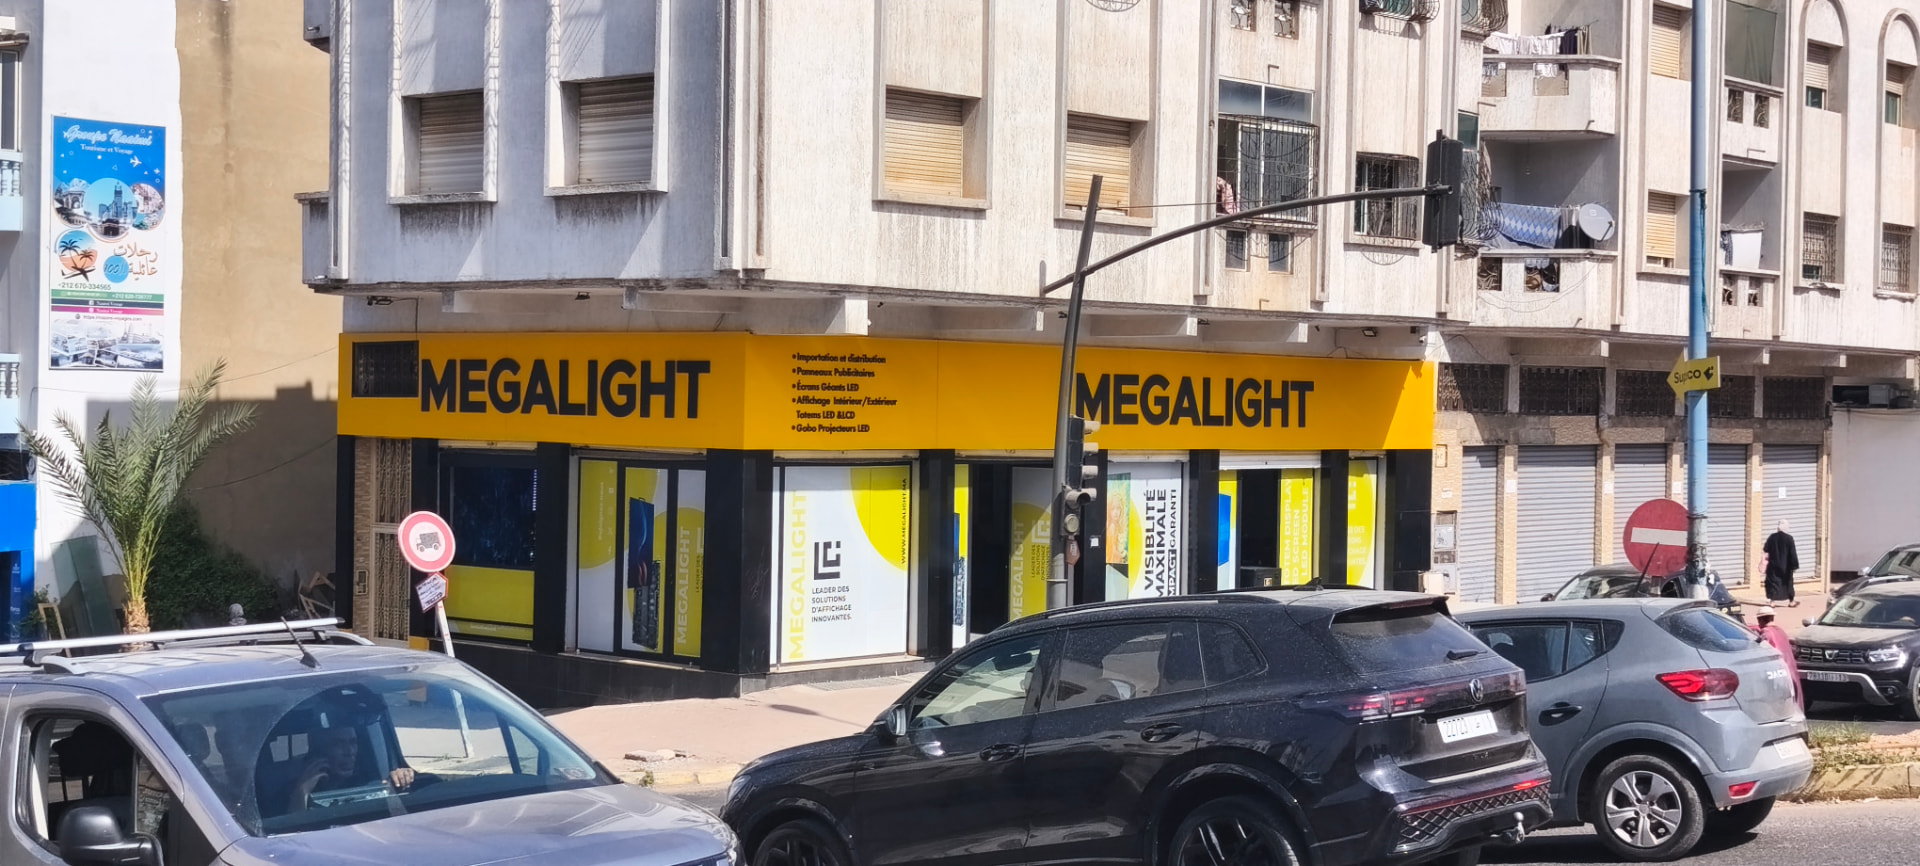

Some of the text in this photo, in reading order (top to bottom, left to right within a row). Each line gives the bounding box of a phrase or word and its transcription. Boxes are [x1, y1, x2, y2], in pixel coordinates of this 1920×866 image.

[113, 242, 158, 263] رحلات
[128, 256, 158, 281] عائلية
[796, 352, 838, 363] Importation
[847, 353, 886, 364] distribution
[796, 367, 875, 377] Panneaux Publicitaires
[421, 357, 711, 418] MEGALIGHT
[796, 379, 859, 392] Écrans Géants LED
[796, 395, 831, 407] Affichage
[1075, 372, 1315, 428] MEGALIGHT
[796, 410, 821, 419] Totems
[822, 411, 835, 419] LED
[796, 423, 870, 435] Gobo Projecteurs LED
[1284, 480, 1292, 536] DISPLAY
[1301, 486, 1309, 546] MODULE
[788, 490, 807, 660] MEGALIGHT
[1168, 550, 1177, 596] MPACT
[677, 525, 691, 644] MEGALIGHT
[811, 585, 850, 595] LEADER DES
[811, 595, 847, 604] SOLUTIONS
[811, 604, 852, 613] D'AFFICHAGE
[811, 613, 852, 623] INNOVANTES.
